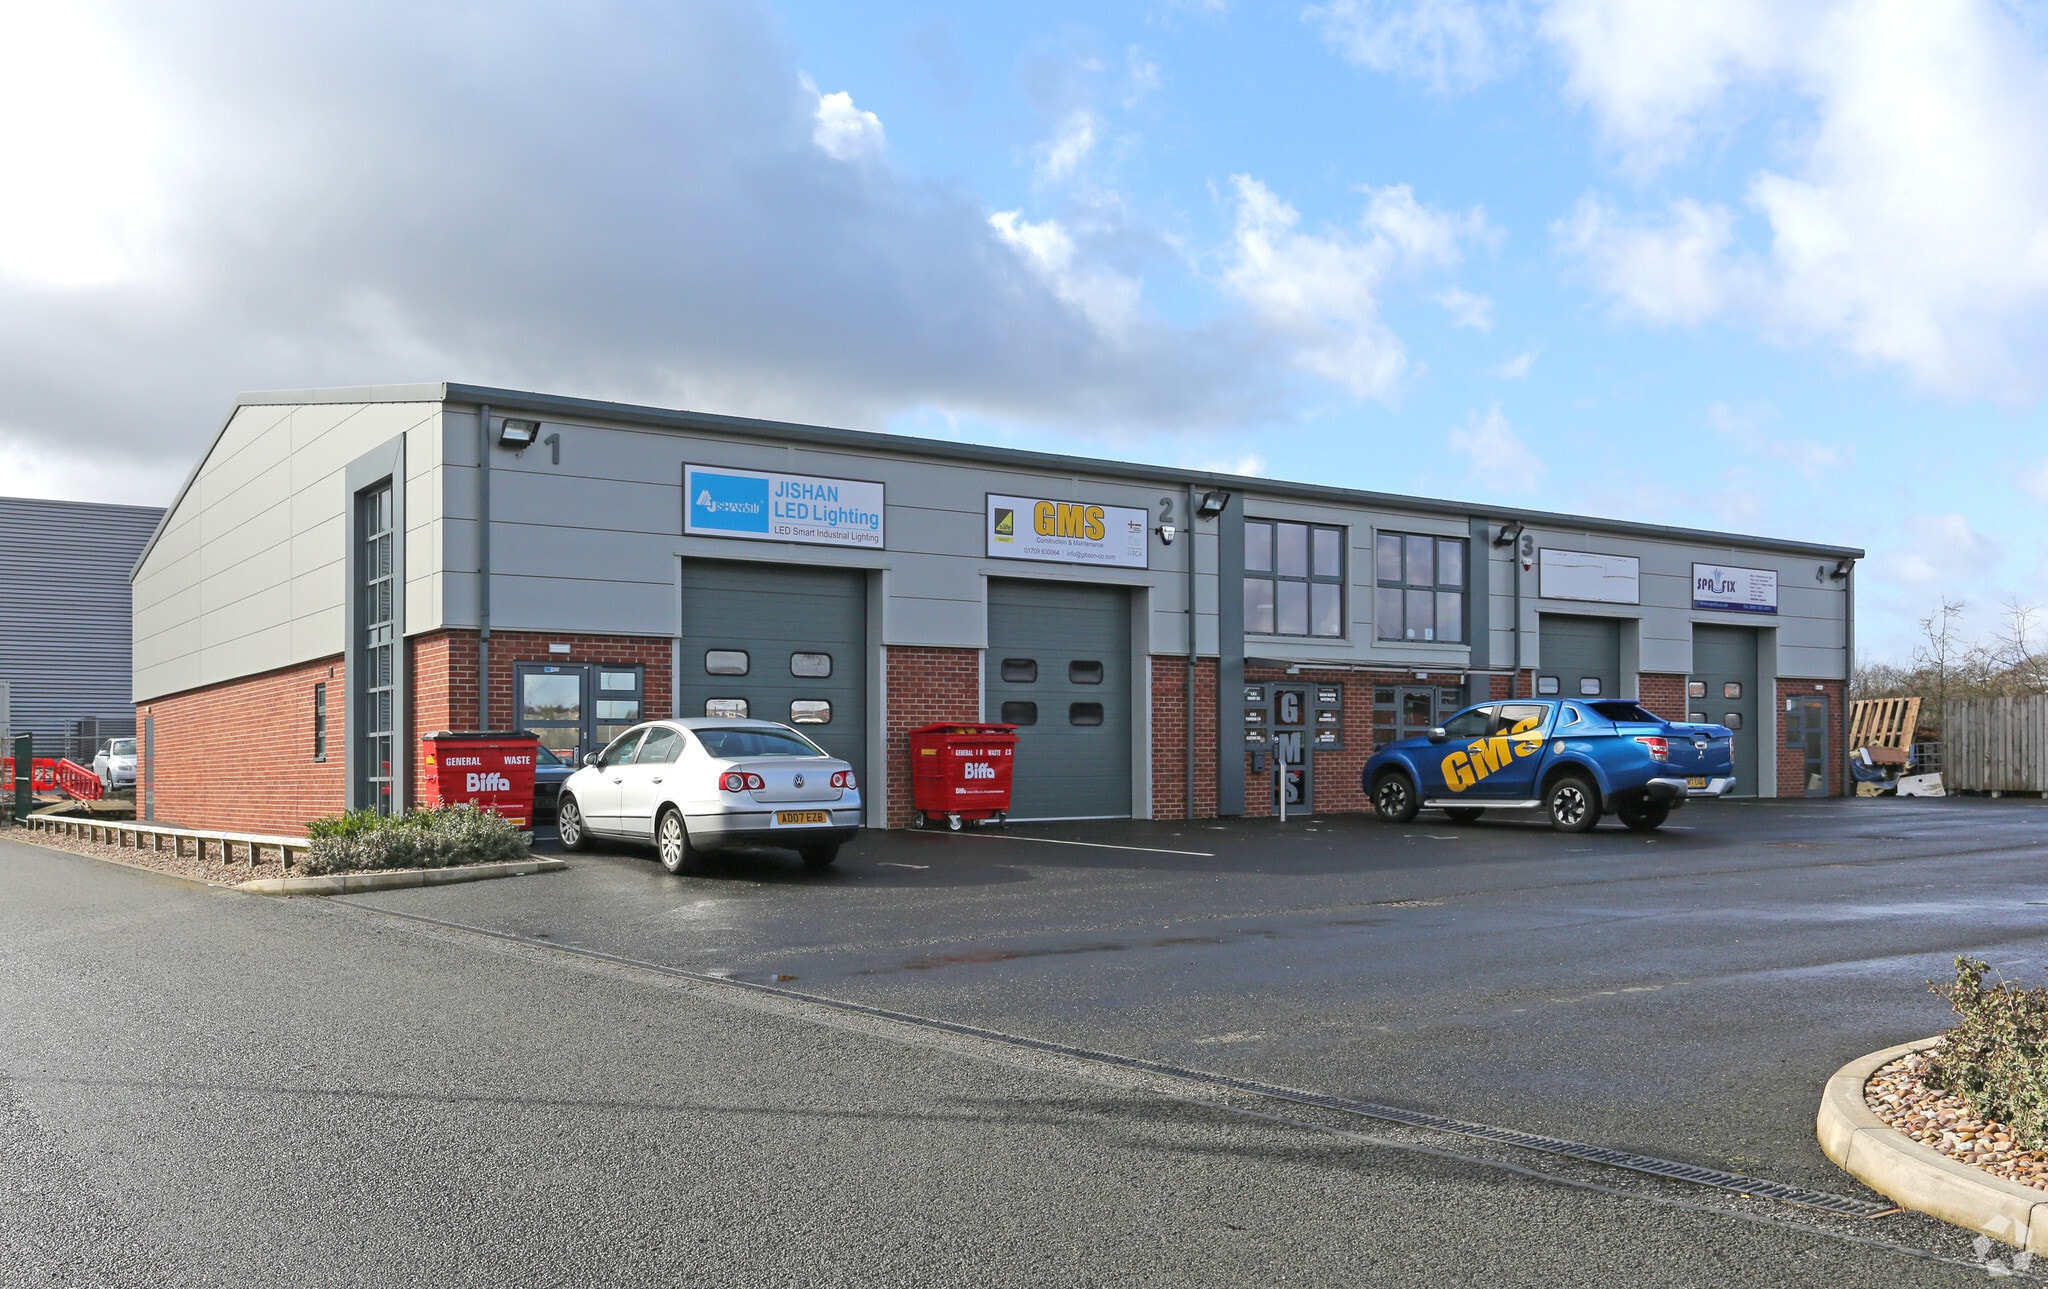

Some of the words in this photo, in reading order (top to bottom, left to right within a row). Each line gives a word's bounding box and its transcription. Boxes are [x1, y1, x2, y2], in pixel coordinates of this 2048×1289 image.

[544, 433, 560, 465] 1
[775, 481, 838, 502] JISHAN
[774, 502, 809, 520] LED
[813, 505, 879, 530] Lighting
[1033, 500, 1106, 541] GMS
[1159, 498, 1173, 522] 2
[774, 525, 791, 535] LED
[793, 527, 815, 537] Smart
[817, 528, 850, 540] Industrial
[851, 531, 879, 544] Lighting
[1036, 536, 1068, 546] Construction
[1068, 538, 1073, 546] &
[1073, 539, 1104, 548] Maintenance
[1521, 535, 1534, 557] 3
[1697, 578, 1714, 591] SPA
[1721, 580, 1736, 593] FIX
[1815, 566, 1824, 584] 4
[446, 757, 481, 766] GENERAL
[504, 756, 531, 765] WASTE
[1441, 716, 1543, 793] GMS
[964, 762, 995, 779] Biffa
[466, 772, 510, 793] Biffa
[781, 814, 804, 824] AD07
[806, 812, 823, 823] EZB
